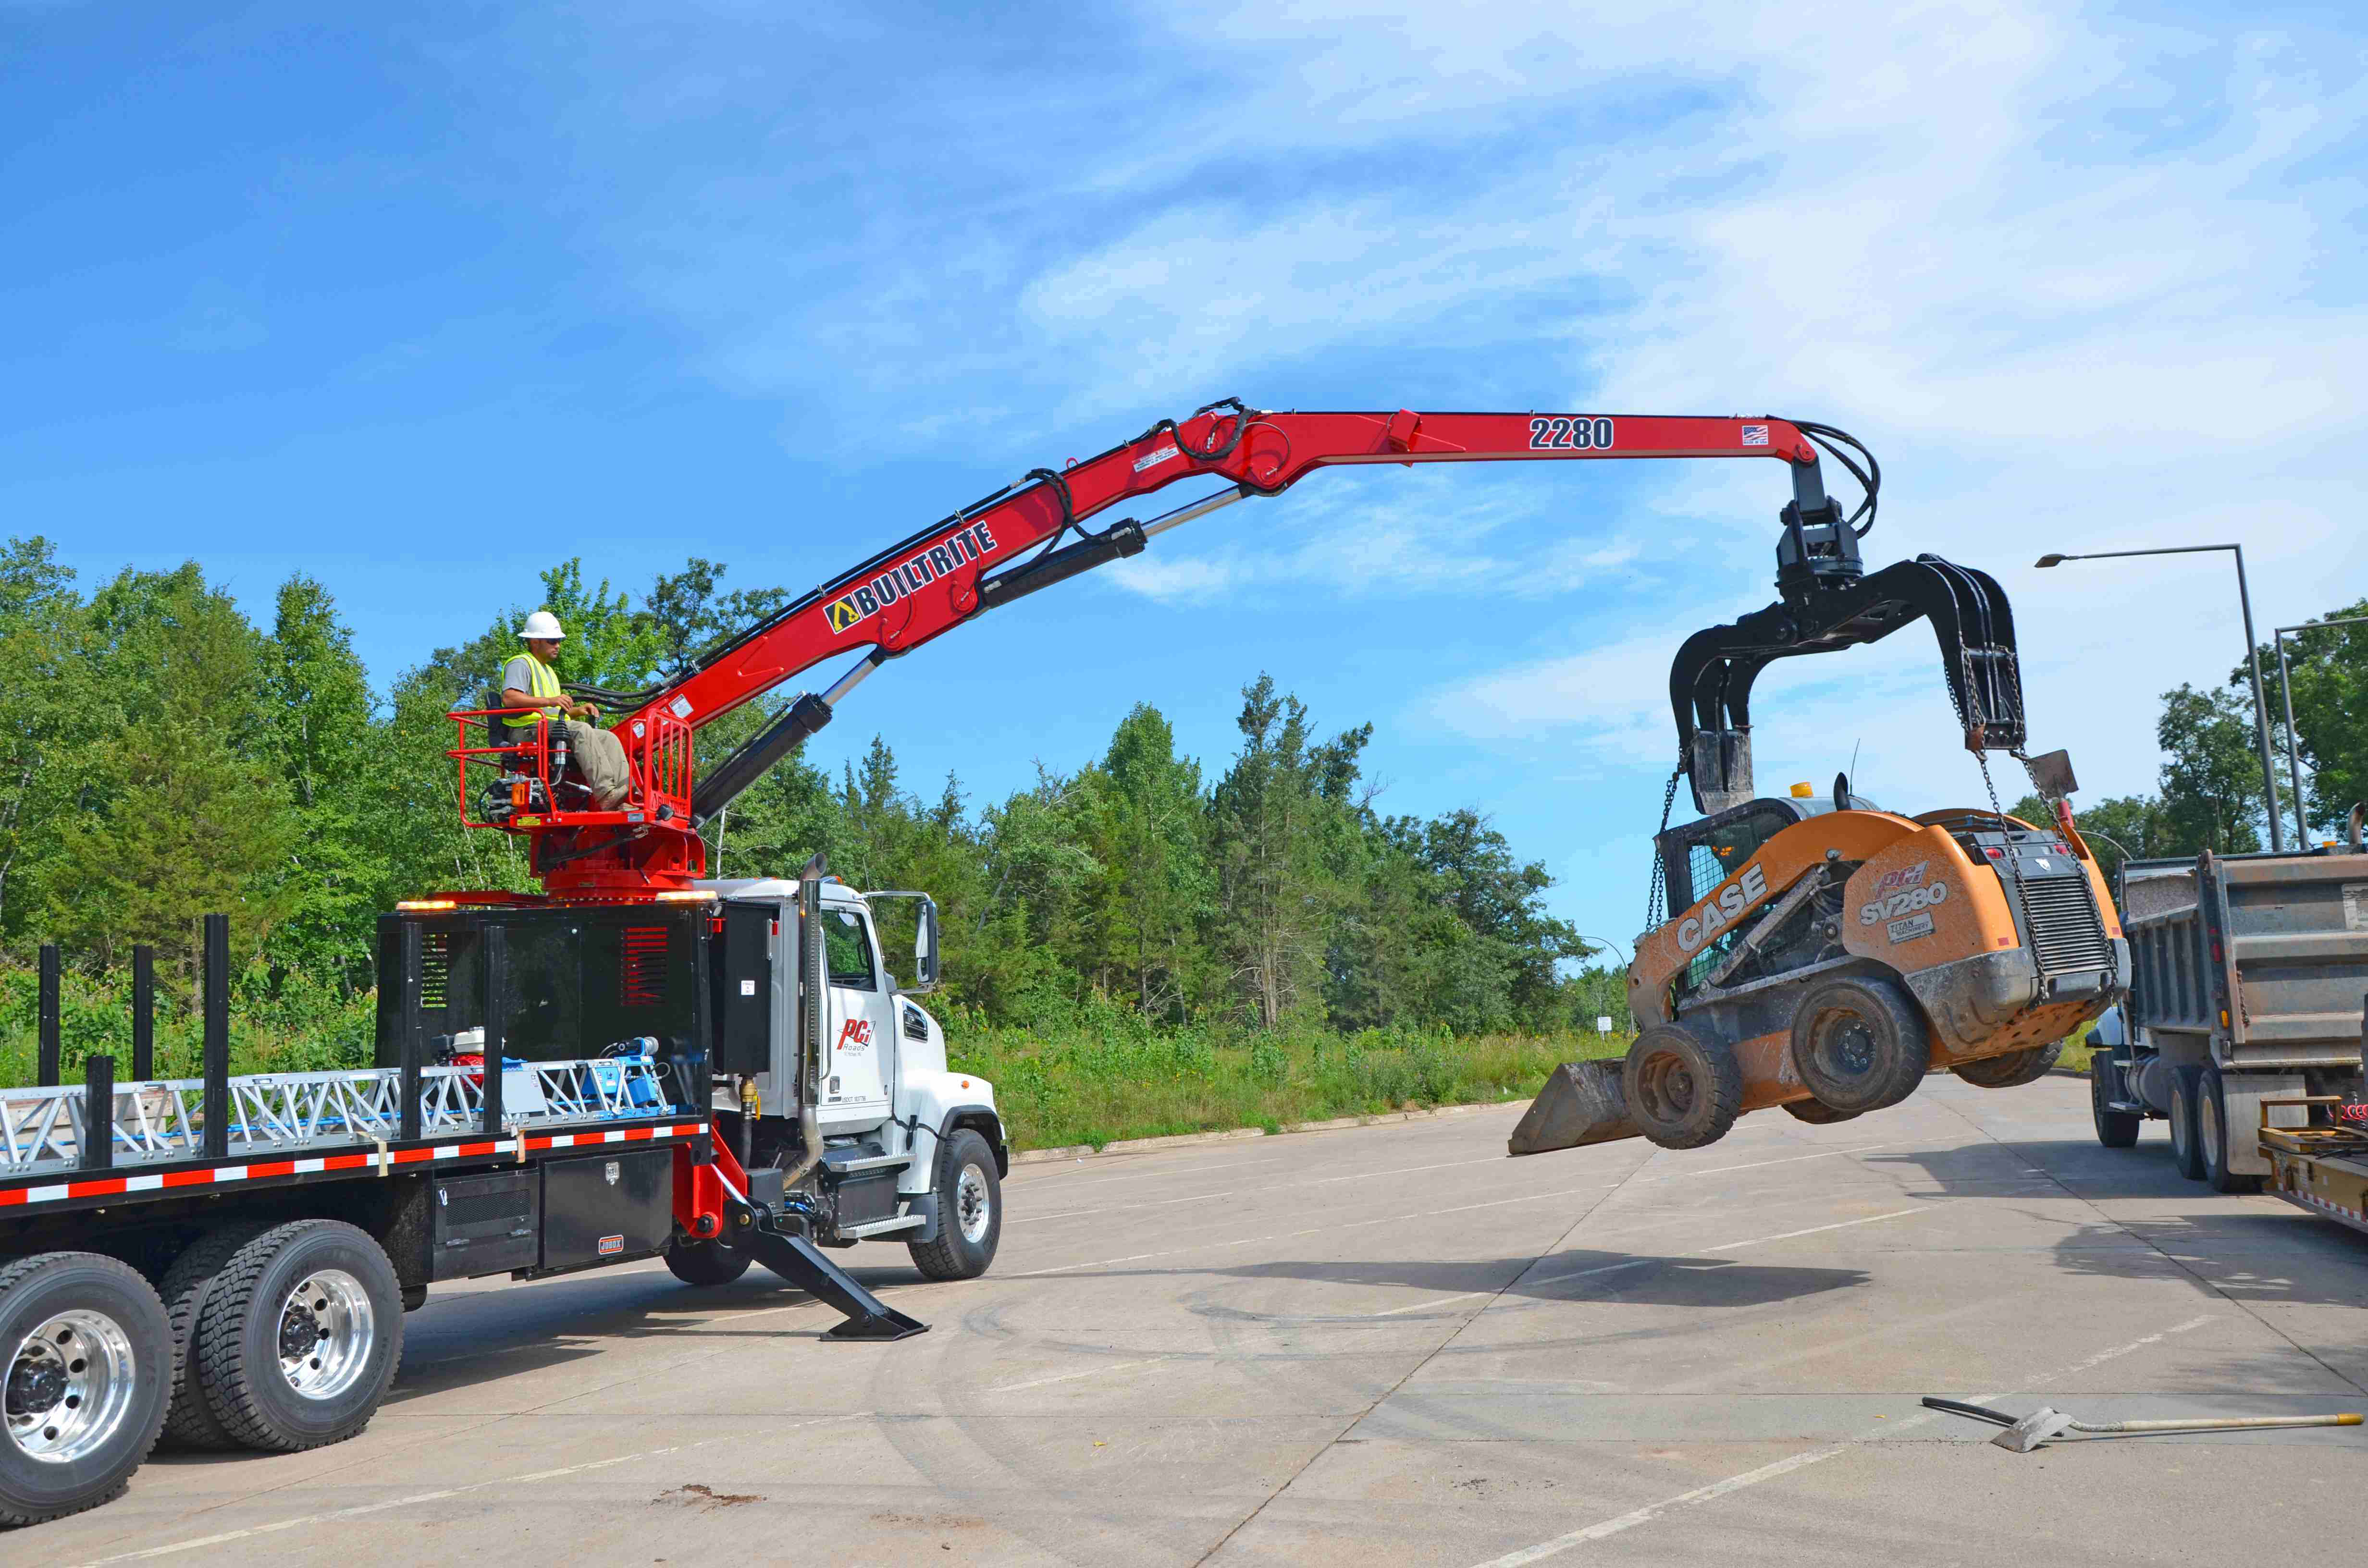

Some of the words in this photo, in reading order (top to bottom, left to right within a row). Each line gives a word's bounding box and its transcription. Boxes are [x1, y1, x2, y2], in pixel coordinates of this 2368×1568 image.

[1530, 417, 1614, 450] 2280
[852, 520, 998, 619] BUILTRITE
[1677, 862, 1768, 952] CASE
[1860, 881, 1948, 926] SV280
[1890, 919, 1913, 933] TITAN
[843, 1043, 865, 1051] Roads
[601, 1239, 621, 1250] JOBOX
